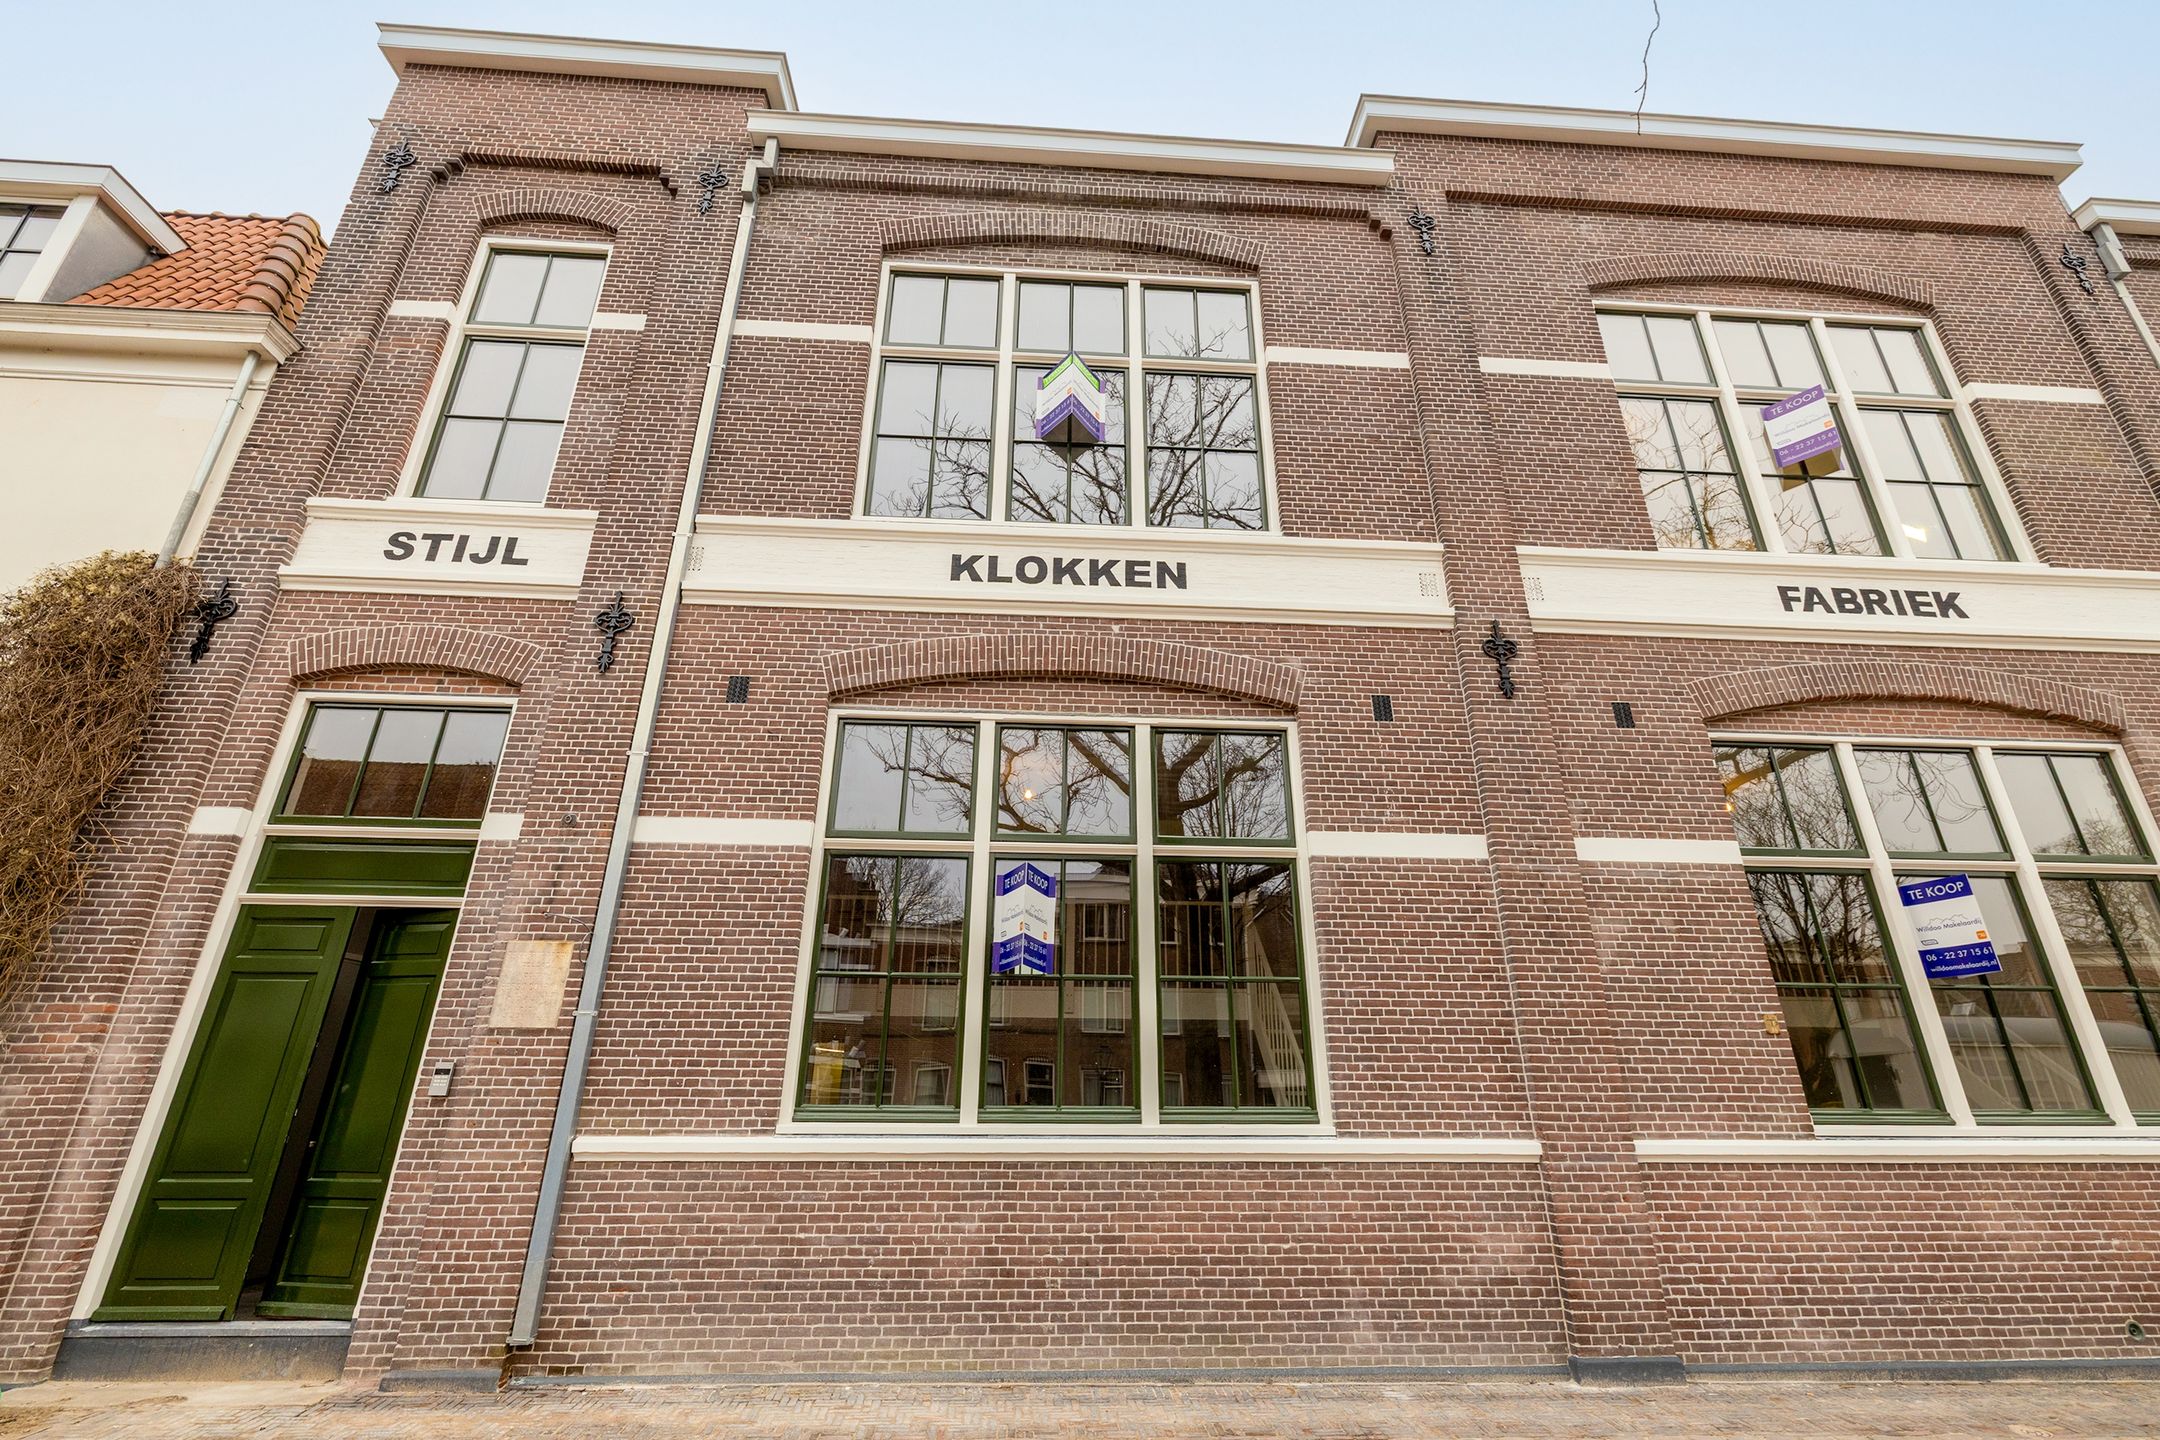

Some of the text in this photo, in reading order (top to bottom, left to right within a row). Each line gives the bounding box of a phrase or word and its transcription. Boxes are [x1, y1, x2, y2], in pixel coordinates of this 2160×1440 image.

[1770, 390, 1818, 416] TE KOOP
[383, 531, 529, 566] STIJL
[950, 553, 1187, 590] KLOKKEN
[1776, 585, 1970, 619] FABRIEK
[1034, 874, 1048, 890] KOOP
[1907, 881, 1964, 900] TE KOOP
[1916, 925, 1942, 933] Willdoo
[1926, 954, 1938, 962] 06
[1944, 952, 1956, 960] 22
[1970, 948, 1981, 956] 15
